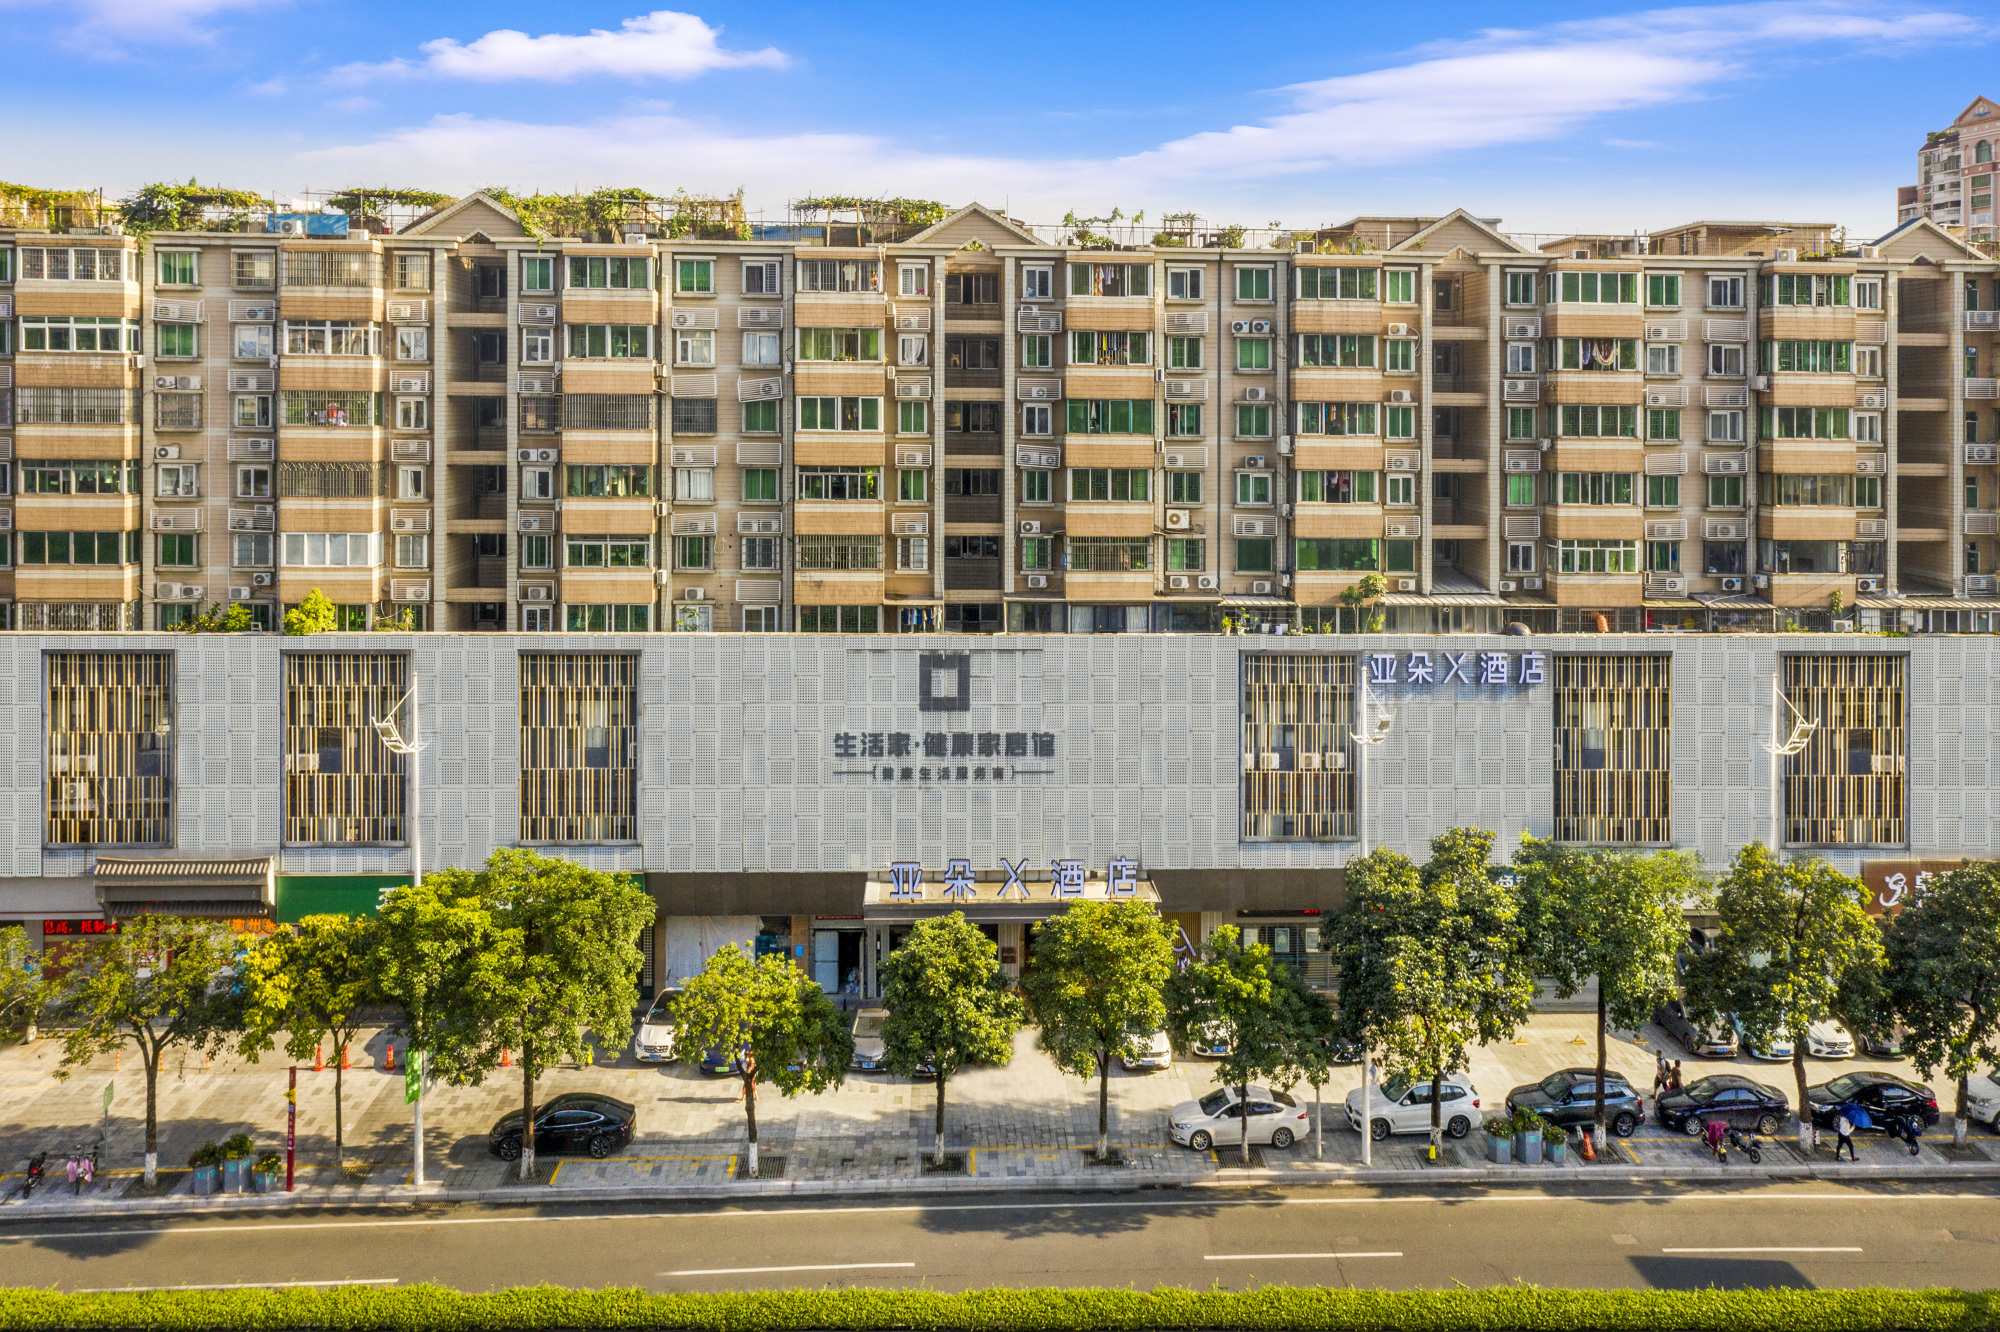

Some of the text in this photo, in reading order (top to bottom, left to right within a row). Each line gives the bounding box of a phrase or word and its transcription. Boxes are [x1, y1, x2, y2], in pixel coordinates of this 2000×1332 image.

[1370, 652, 1546, 684] 亚朵X酒店
[890, 856, 1139, 898] 亚朵X酒店
